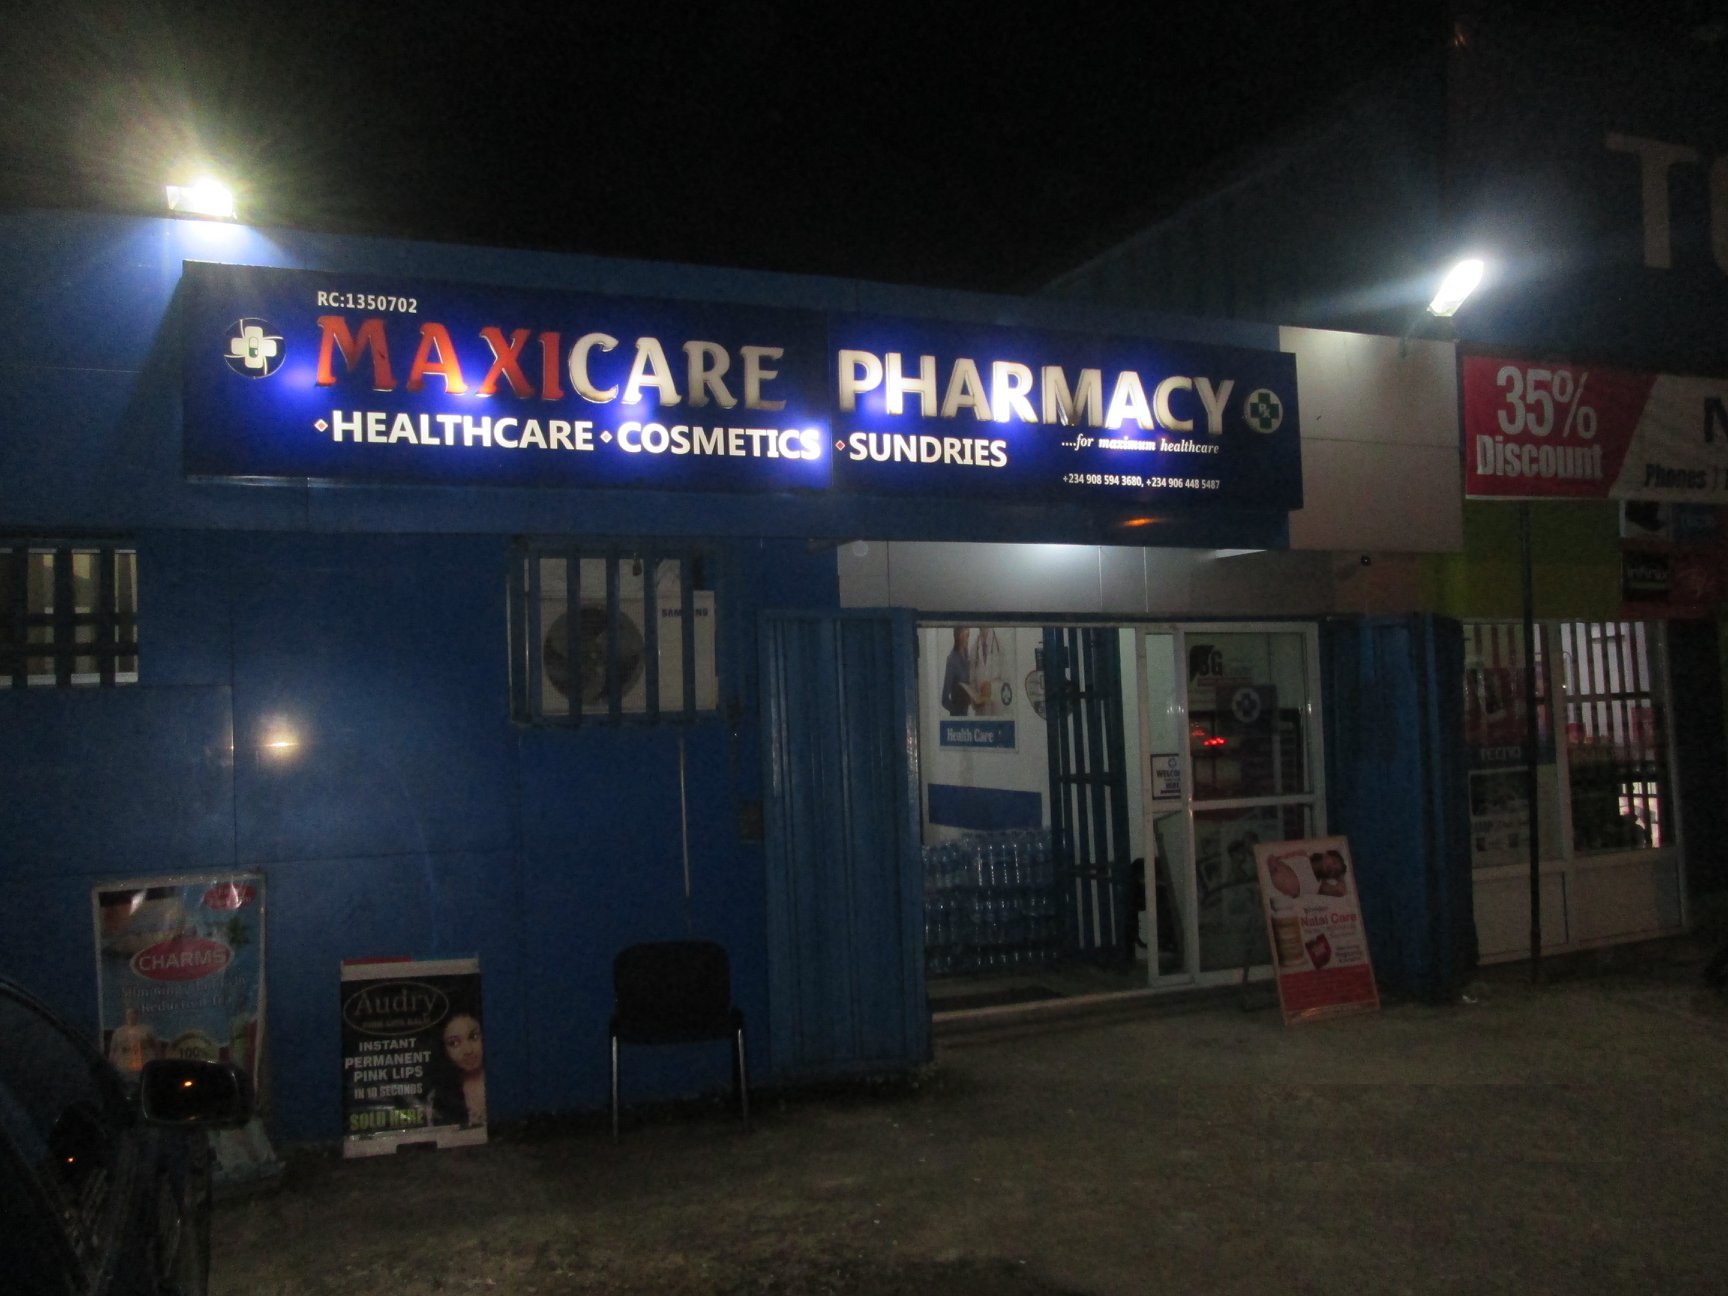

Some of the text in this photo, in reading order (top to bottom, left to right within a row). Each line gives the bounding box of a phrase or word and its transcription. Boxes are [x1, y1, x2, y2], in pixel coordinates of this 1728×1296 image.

[316, 290, 418, 313] RC:1350702
[316, 315, 1235, 436] MAXICARE PHARMACY
[1496, 366, 1598, 440] 35%
[331, 410, 1009, 468] HEALTHCARE COSMETICS SUNDRIES
[1098, 436, 1157, 452] maximum
[1160, 438, 1220, 455] healthcare
[1475, 433, 1604, 480] Discount
[1062, 473, 1085, 485] +234
[1086, 474, 1102, 486] 908
[1104, 475, 1120, 486] 594
[1146, 476, 1167, 488] +234
[1168, 477, 1184, 489] 906
[1185, 478, 1200, 489] 448
[1201, 479, 1221, 490] 5487
[946, 726, 995, 743] Health Care
[138, 950, 227, 972] CHARMS
[352, 987, 439, 1018] Audry
[358, 1037, 417, 1052] INSTANT
[344, 1050, 432, 1070] PERMANENT
[353, 1065, 424, 1083] PINK LIPS
[354, 1088, 365, 1100] IN
[380, 1082, 423, 1097] SECONDS
